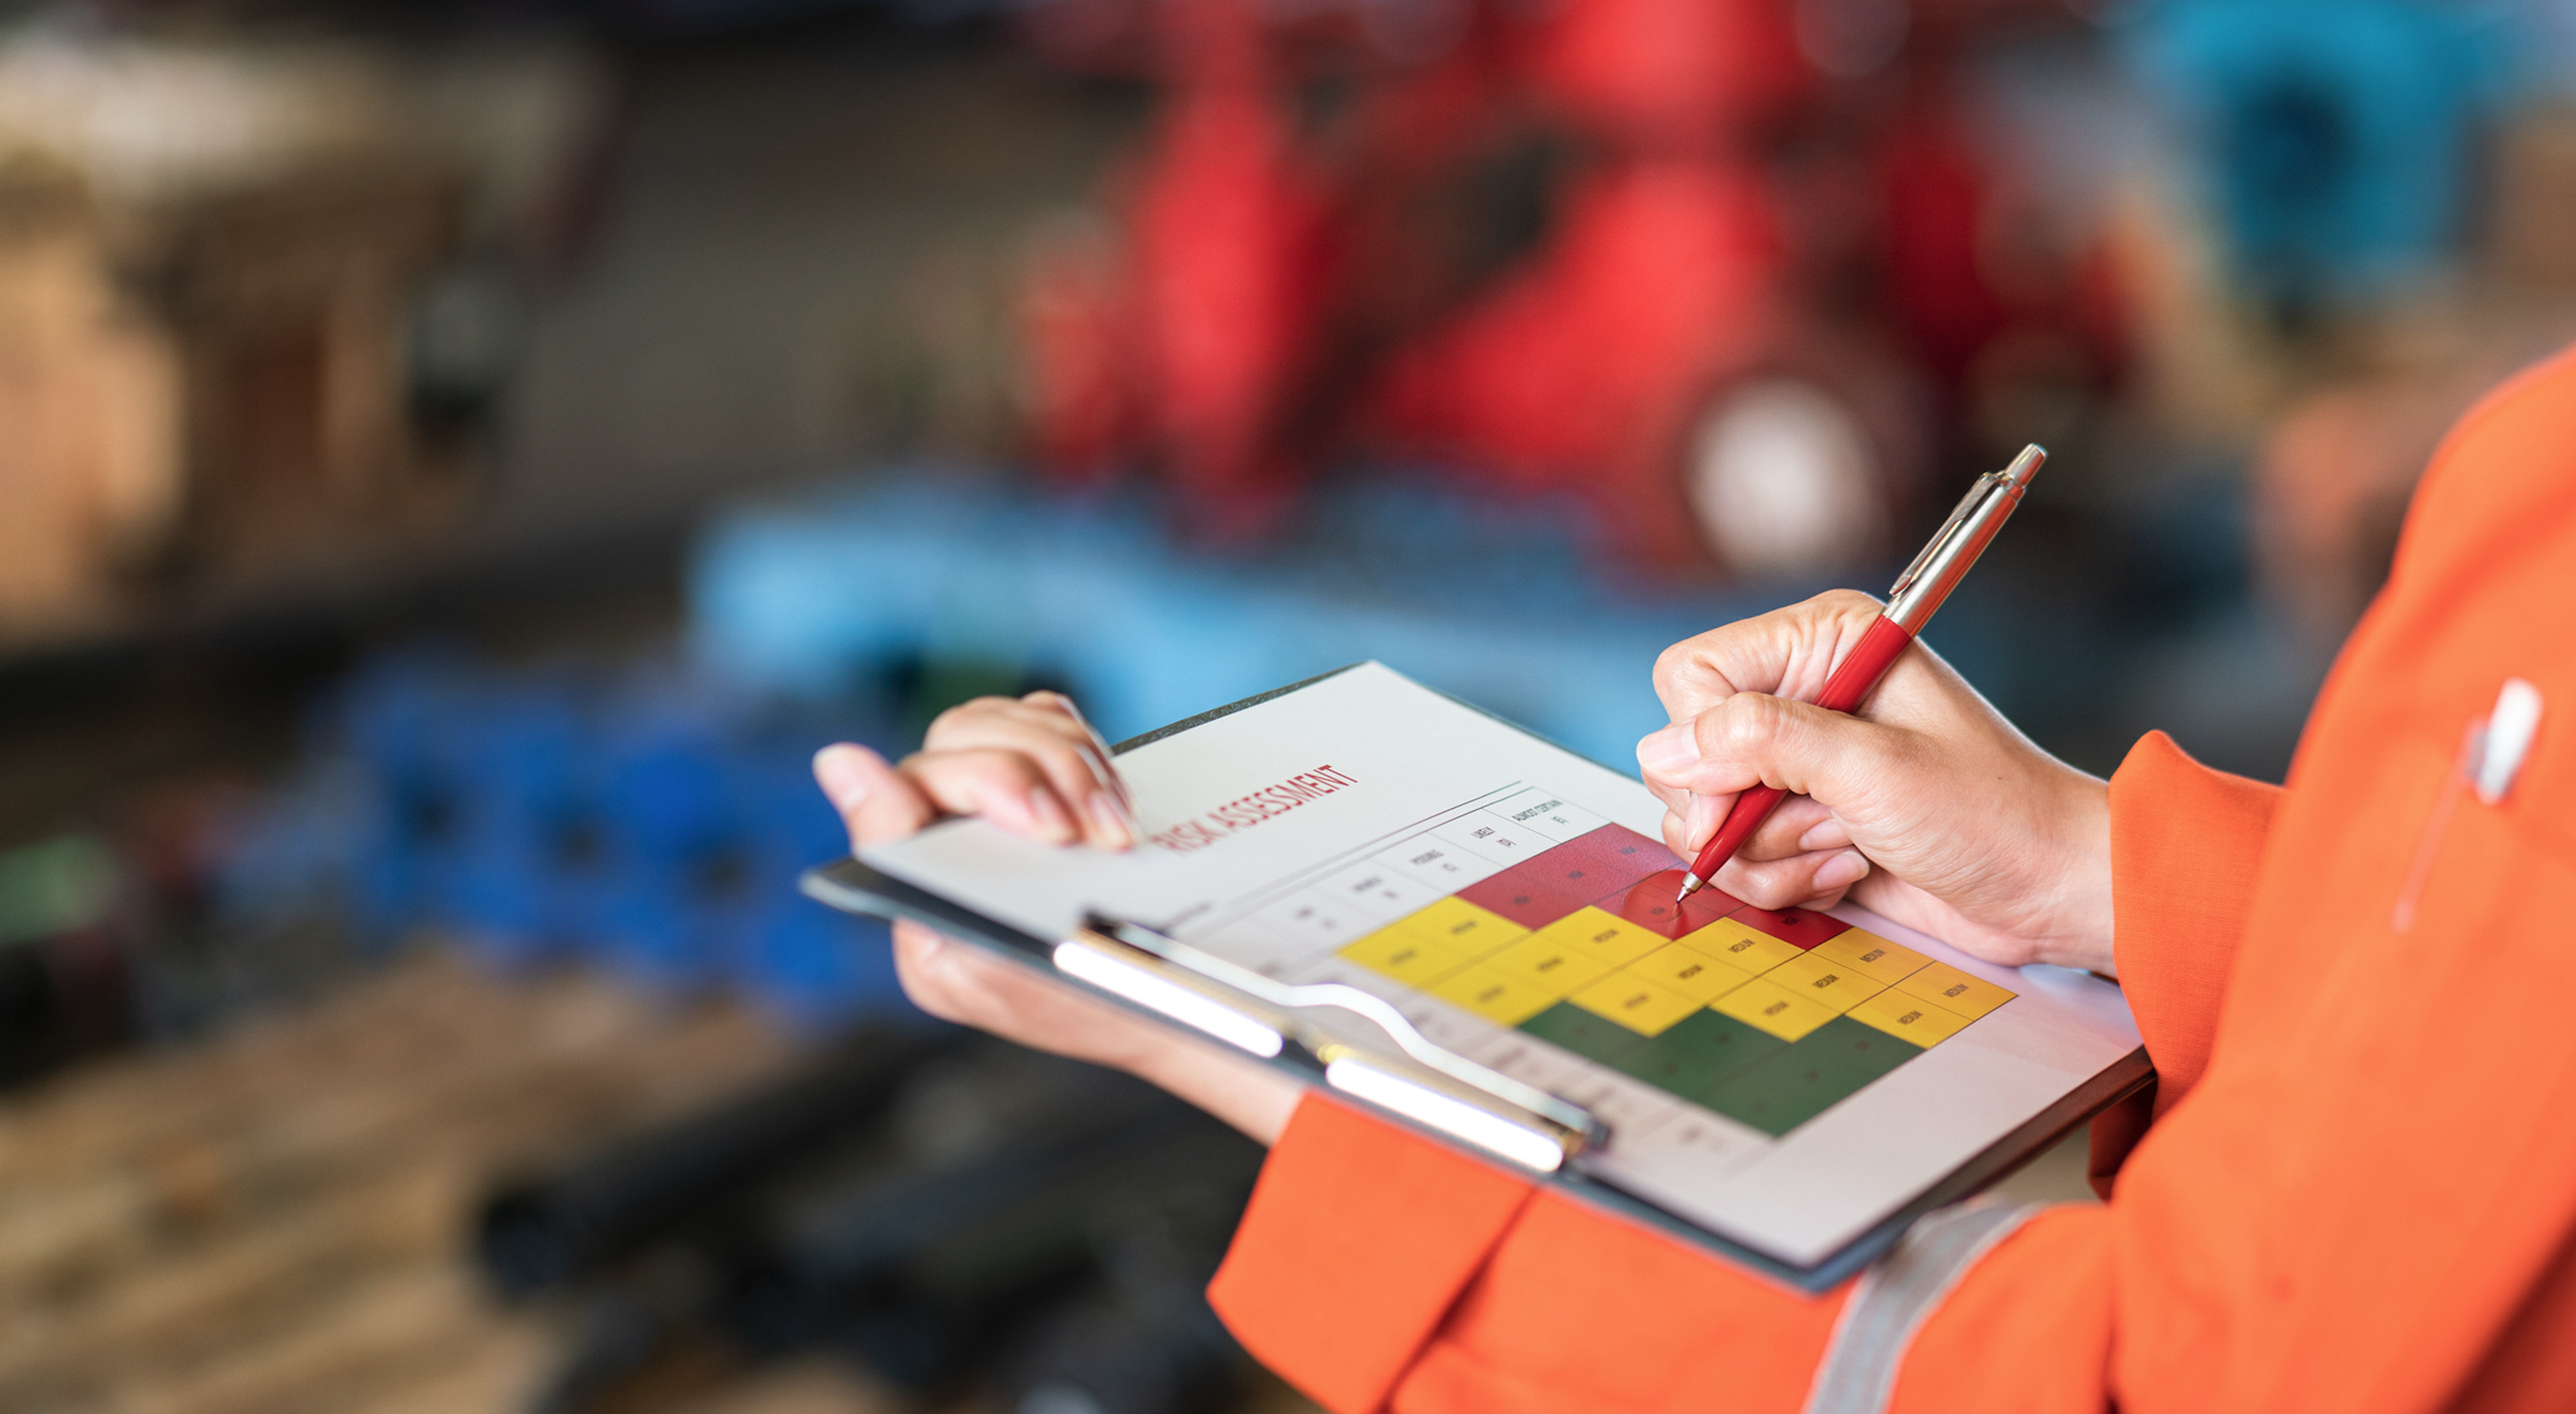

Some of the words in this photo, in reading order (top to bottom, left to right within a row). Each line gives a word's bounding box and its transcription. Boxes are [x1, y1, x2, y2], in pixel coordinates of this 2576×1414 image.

[1150, 818, 1227, 856] RISK
[1206, 764, 1357, 832] ASSESSMENT
[1511, 808, 1540, 822] ALMOST
[1470, 826, 1496, 838] LIKELY
[1728, 938, 1756, 954] MEDIUM
[1859, 949, 1887, 963] MEDIUM
[1812, 974, 1839, 989] MEDIUM
[1942, 983, 1969, 998] MEDIUM
[1897, 1010, 1924, 1025] MEDIUM
